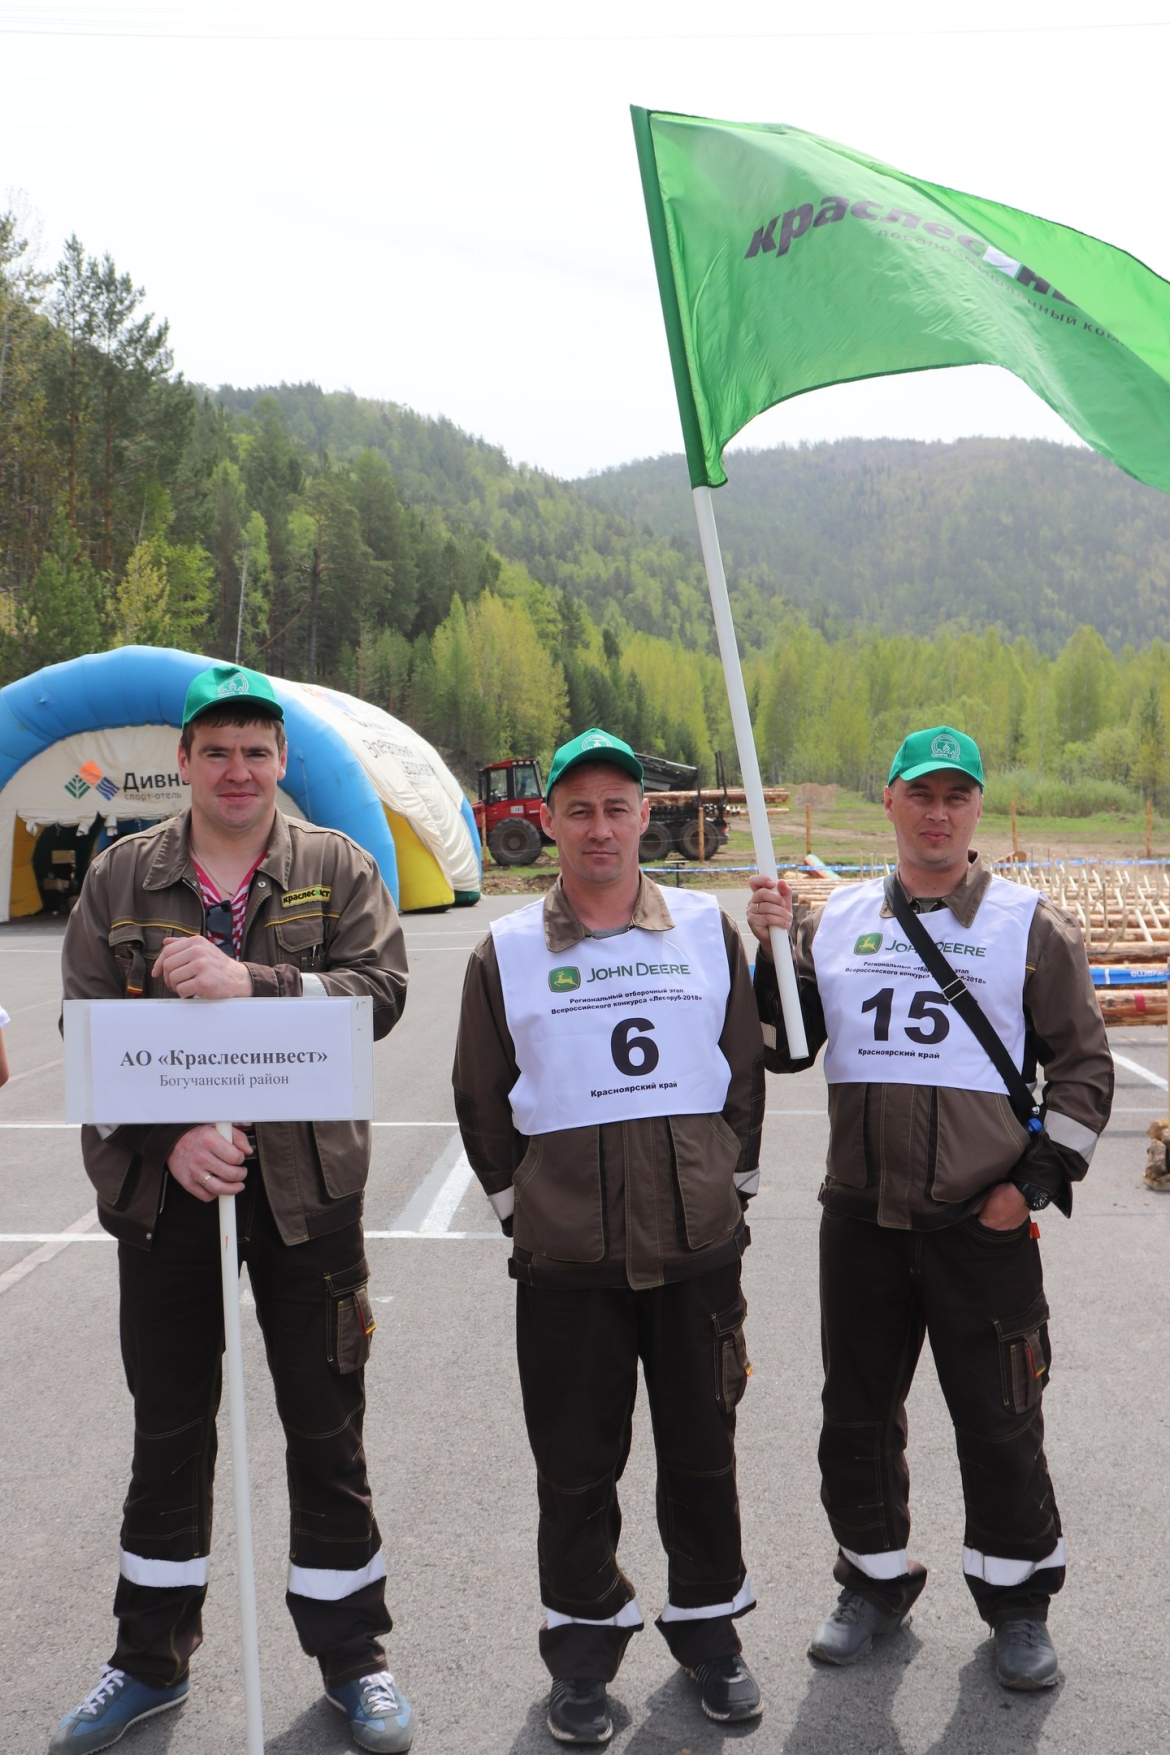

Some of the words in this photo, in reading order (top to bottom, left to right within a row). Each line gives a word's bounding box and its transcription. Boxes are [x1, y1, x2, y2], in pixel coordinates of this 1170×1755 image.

[1083, 321, 1125, 348] ком
[124, 792, 182, 802] спорт-отель
[885, 940, 918, 954] JOH
[586, 964, 633, 983] JOHN
[636, 962, 691, 977] DEERE
[845, 967, 898, 976] Всероссийского
[899, 971, 930, 980] конкурса
[551, 1002, 612, 1015] Всероссийского
[612, 997, 648, 1008] конкурса
[649, 994, 703, 1003] «Лесоруб-2018»
[569, 992, 623, 1004] Региональный
[624, 988, 668, 999] отборочный
[861, 987, 950, 1045] 15
[610, 1017, 660, 1077] 6
[858, 1048, 916, 1058] Красноярский
[917, 1050, 940, 1060] край
[119, 1049, 152, 1067] АО
[157, 1049, 328, 1070] «Краслесинвест»
[159, 1073, 246, 1089] Богучанский
[249, 1073, 290, 1088] район
[590, 1082, 657, 1098] Красноярский
[658, 1081, 678, 1091] край
